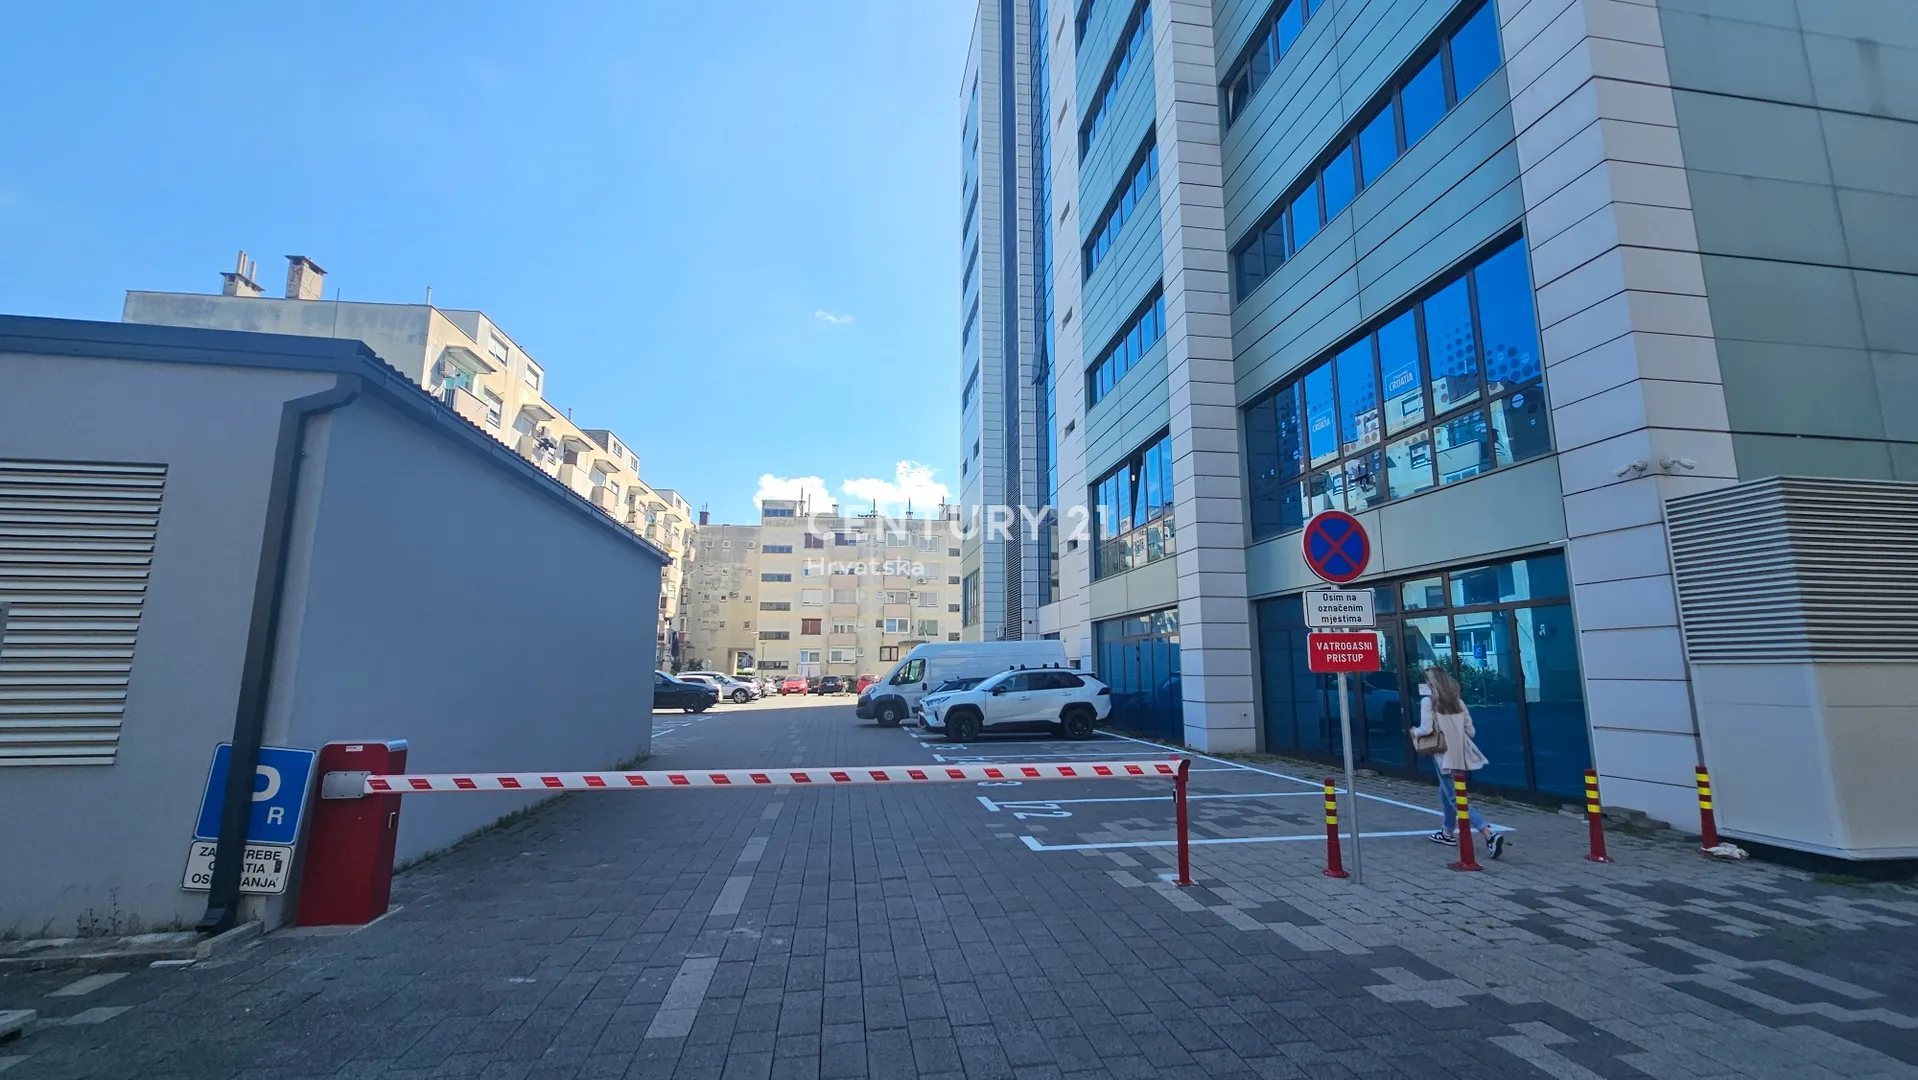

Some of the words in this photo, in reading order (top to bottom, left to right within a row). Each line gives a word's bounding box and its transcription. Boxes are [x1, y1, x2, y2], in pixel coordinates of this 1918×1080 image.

[1389, 372, 1414, 392] CROATIA
[1323, 593, 1344, 601] Osim
[1318, 603, 1364, 613] označenim
[1321, 614, 1362, 625] mjestima
[1316, 642, 1372, 650] VATROGASNI
[1326, 653, 1364, 663] PRISTUP
[267, 806, 285, 825] R
[199, 846, 216, 858] ZA
[208, 861, 265, 874] CTIA
[191, 873, 277, 888] OSANJA
